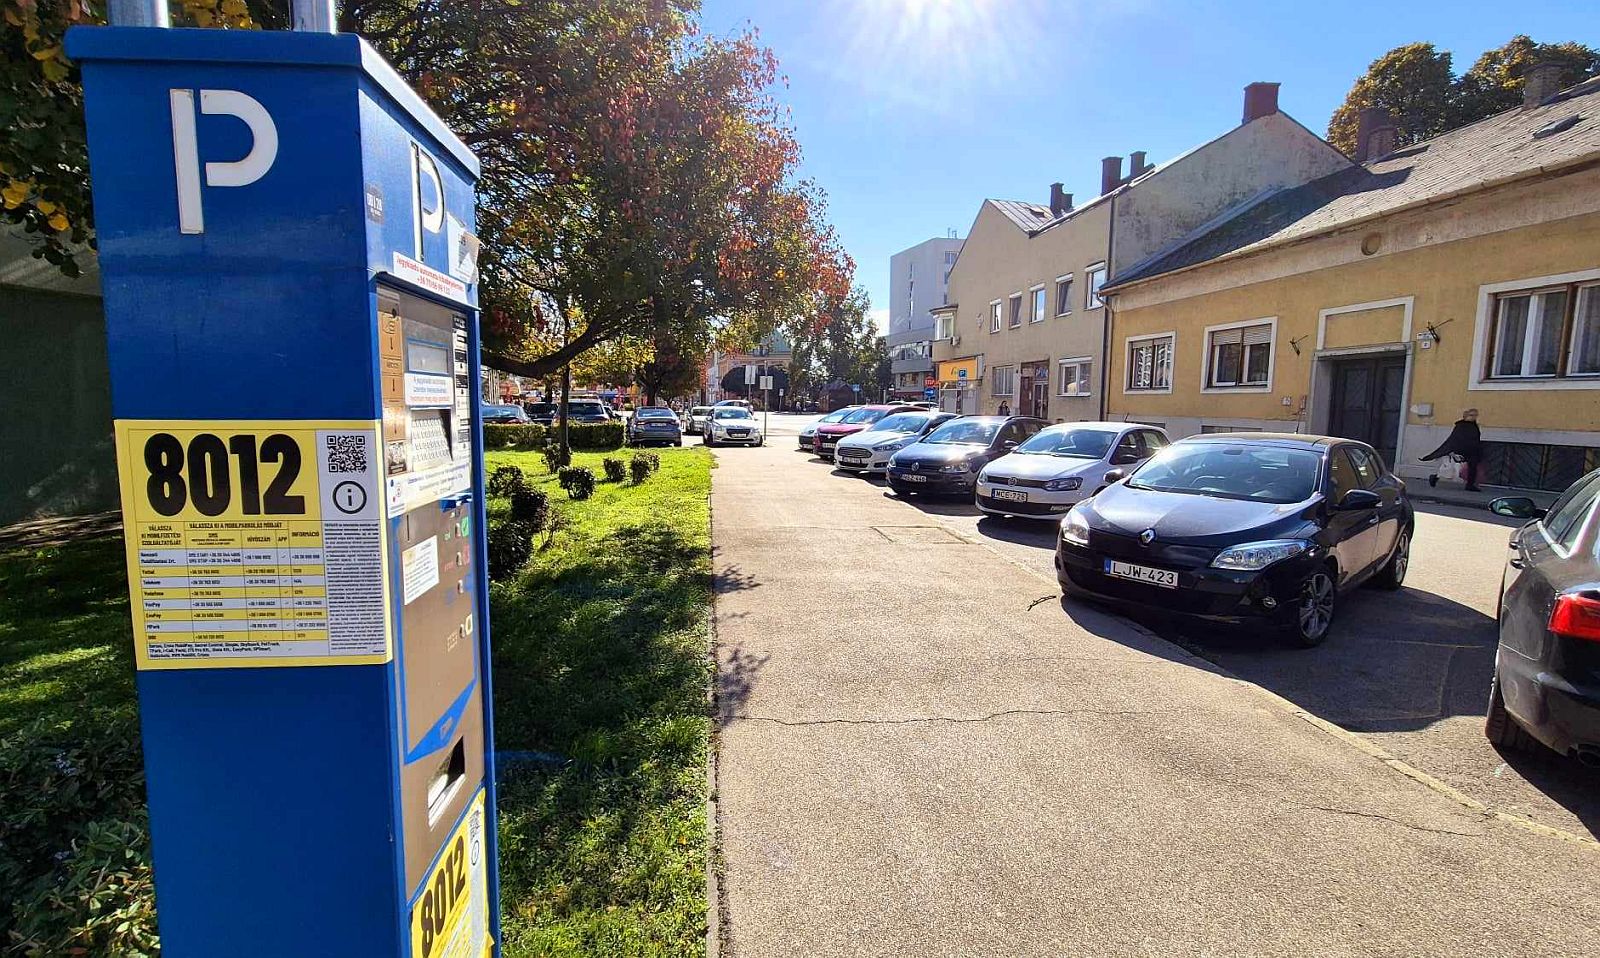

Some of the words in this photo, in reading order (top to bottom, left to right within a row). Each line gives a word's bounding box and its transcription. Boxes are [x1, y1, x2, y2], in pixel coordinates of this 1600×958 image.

[169, 88, 279, 235] P
[410, 140, 445, 262] P
[144, 432, 305, 516] 8012
[1114, 562, 1174, 584] LJW-423
[420, 835, 466, 958] 8012
